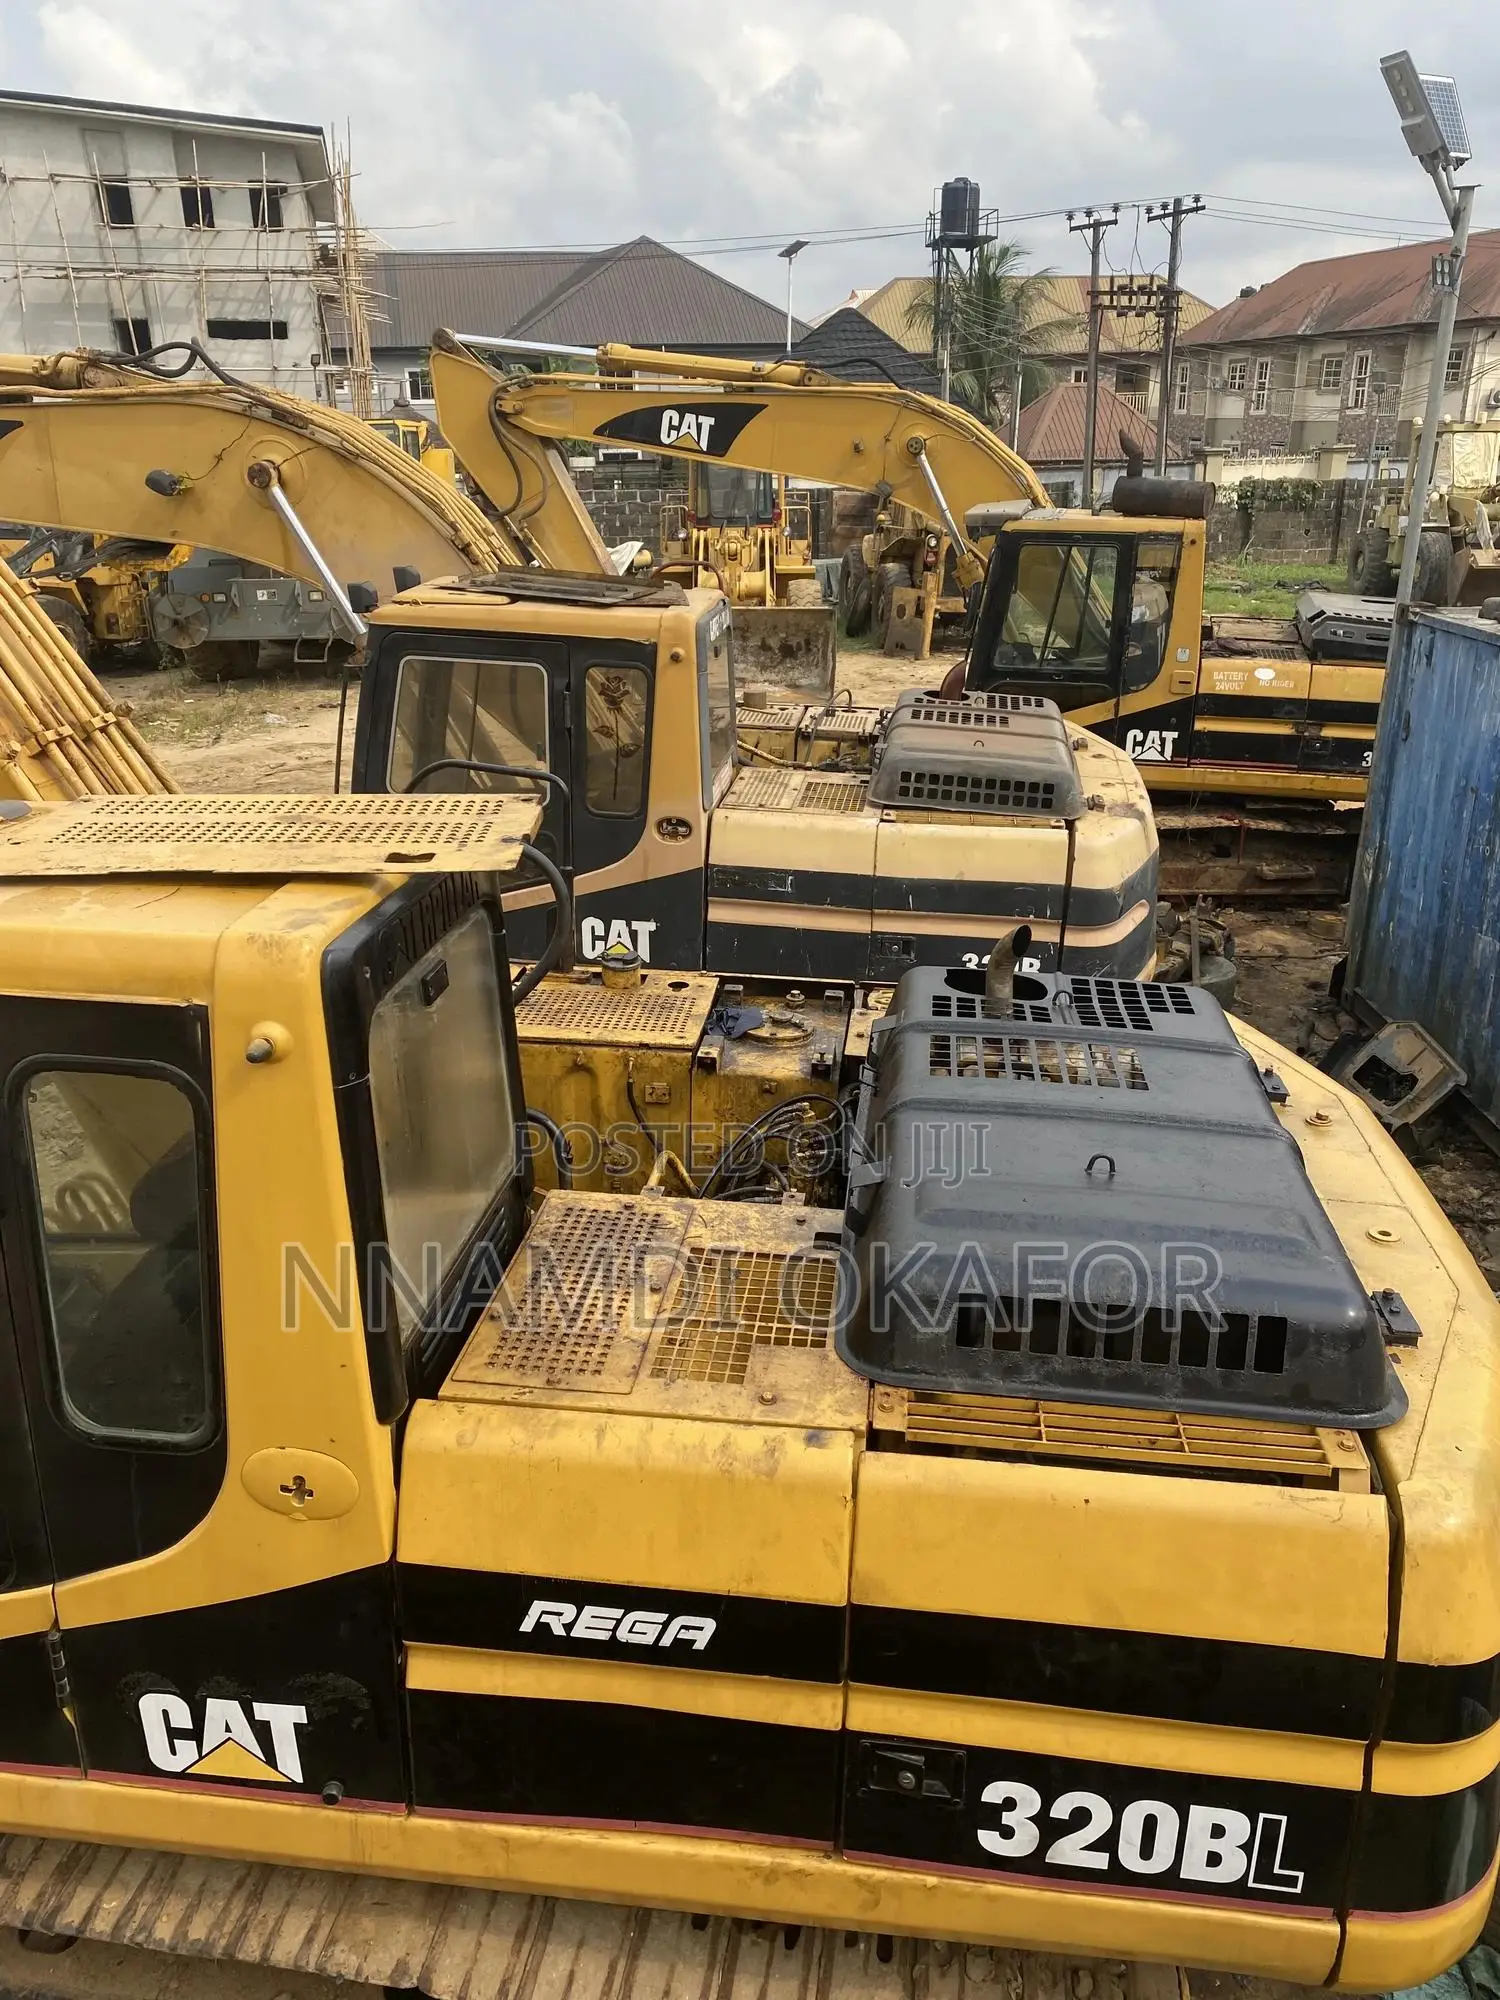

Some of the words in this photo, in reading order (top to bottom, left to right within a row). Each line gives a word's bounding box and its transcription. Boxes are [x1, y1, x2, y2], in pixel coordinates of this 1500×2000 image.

[660, 409, 715, 451] CAT
[1213, 671, 1248, 681] BATTERY
[1215, 681, 1245, 691] 24VOLT
[1125, 729, 1178, 761] CAT
[581, 916, 657, 963] CAT
[519, 1599, 718, 1651] REGA
[137, 1692, 309, 1784] CAT
[976, 1780, 1306, 1894] 320BL
